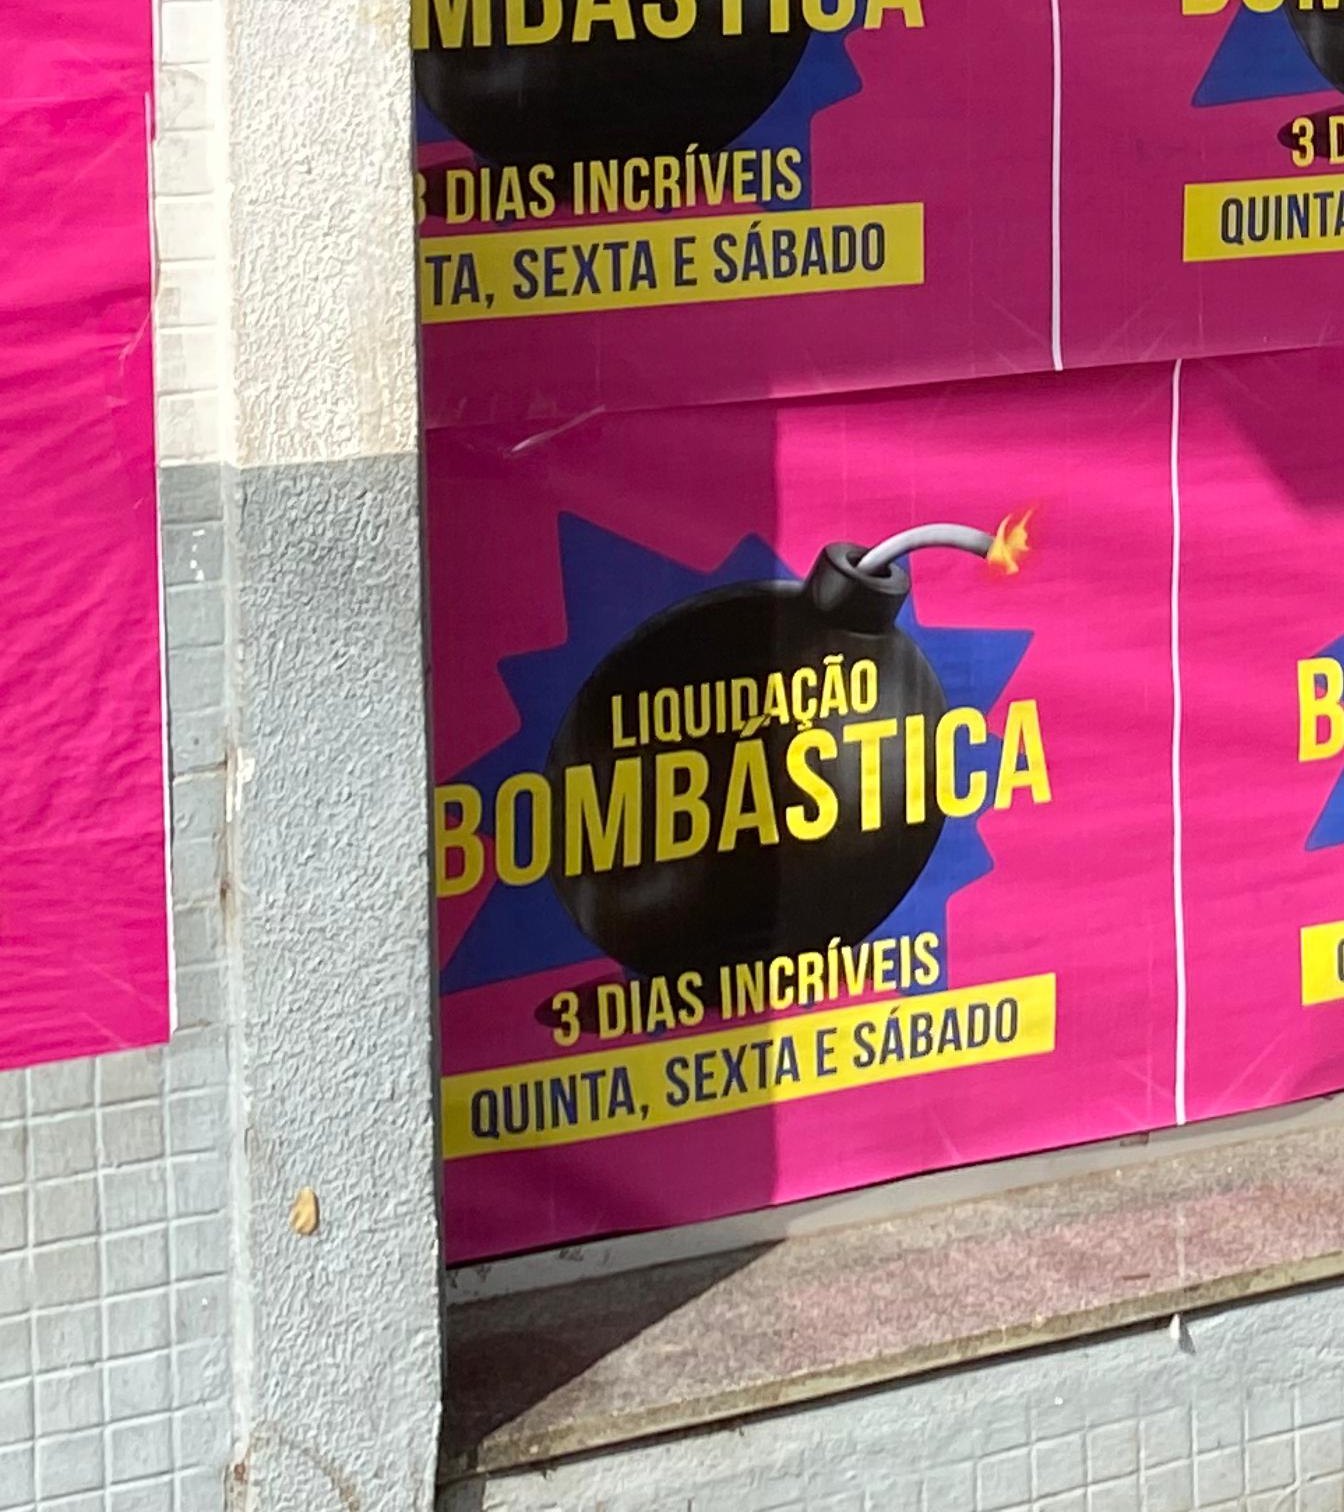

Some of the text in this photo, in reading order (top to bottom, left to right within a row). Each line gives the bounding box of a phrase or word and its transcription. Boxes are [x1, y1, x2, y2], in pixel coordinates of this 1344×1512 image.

[446, 164, 555, 225] DIAS
[574, 143, 802, 216] INCRÍVEIS
[1291, 118, 1315, 167] 3
[514, 238, 657, 301] SEXTA
[675, 236, 696, 287] E
[714, 220, 885, 284] SÁBADO
[611, 654, 877, 749] LIQUIDAÇÃO
[435, 699, 1052, 899] BOMBÁSTICA
[551, 937, 940, 1046] 3 DIAS INCRÍVEIS
[471, 998, 1018, 1140] QUINTA, SEXTA E SÁBADO
